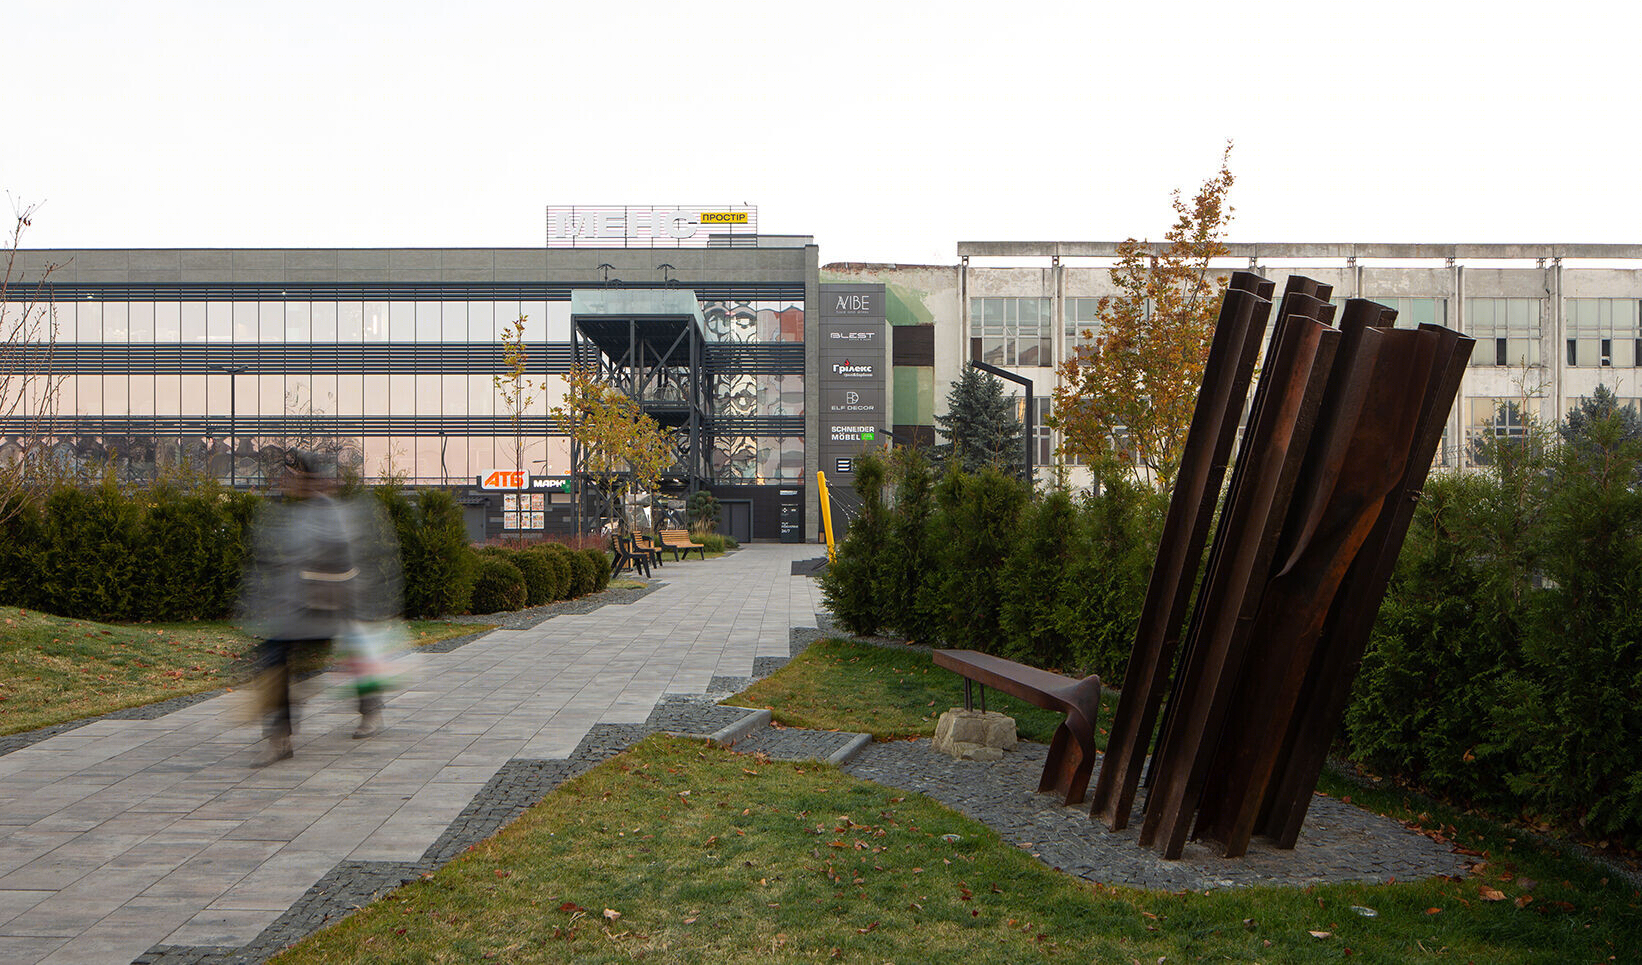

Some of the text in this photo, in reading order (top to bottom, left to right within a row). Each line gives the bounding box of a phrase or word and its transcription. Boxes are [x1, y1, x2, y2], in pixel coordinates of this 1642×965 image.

[702, 213, 746, 221] ПРОСТІР
[833, 360, 872, 374] Грілекс
[831, 432, 861, 440] MÖBEL
